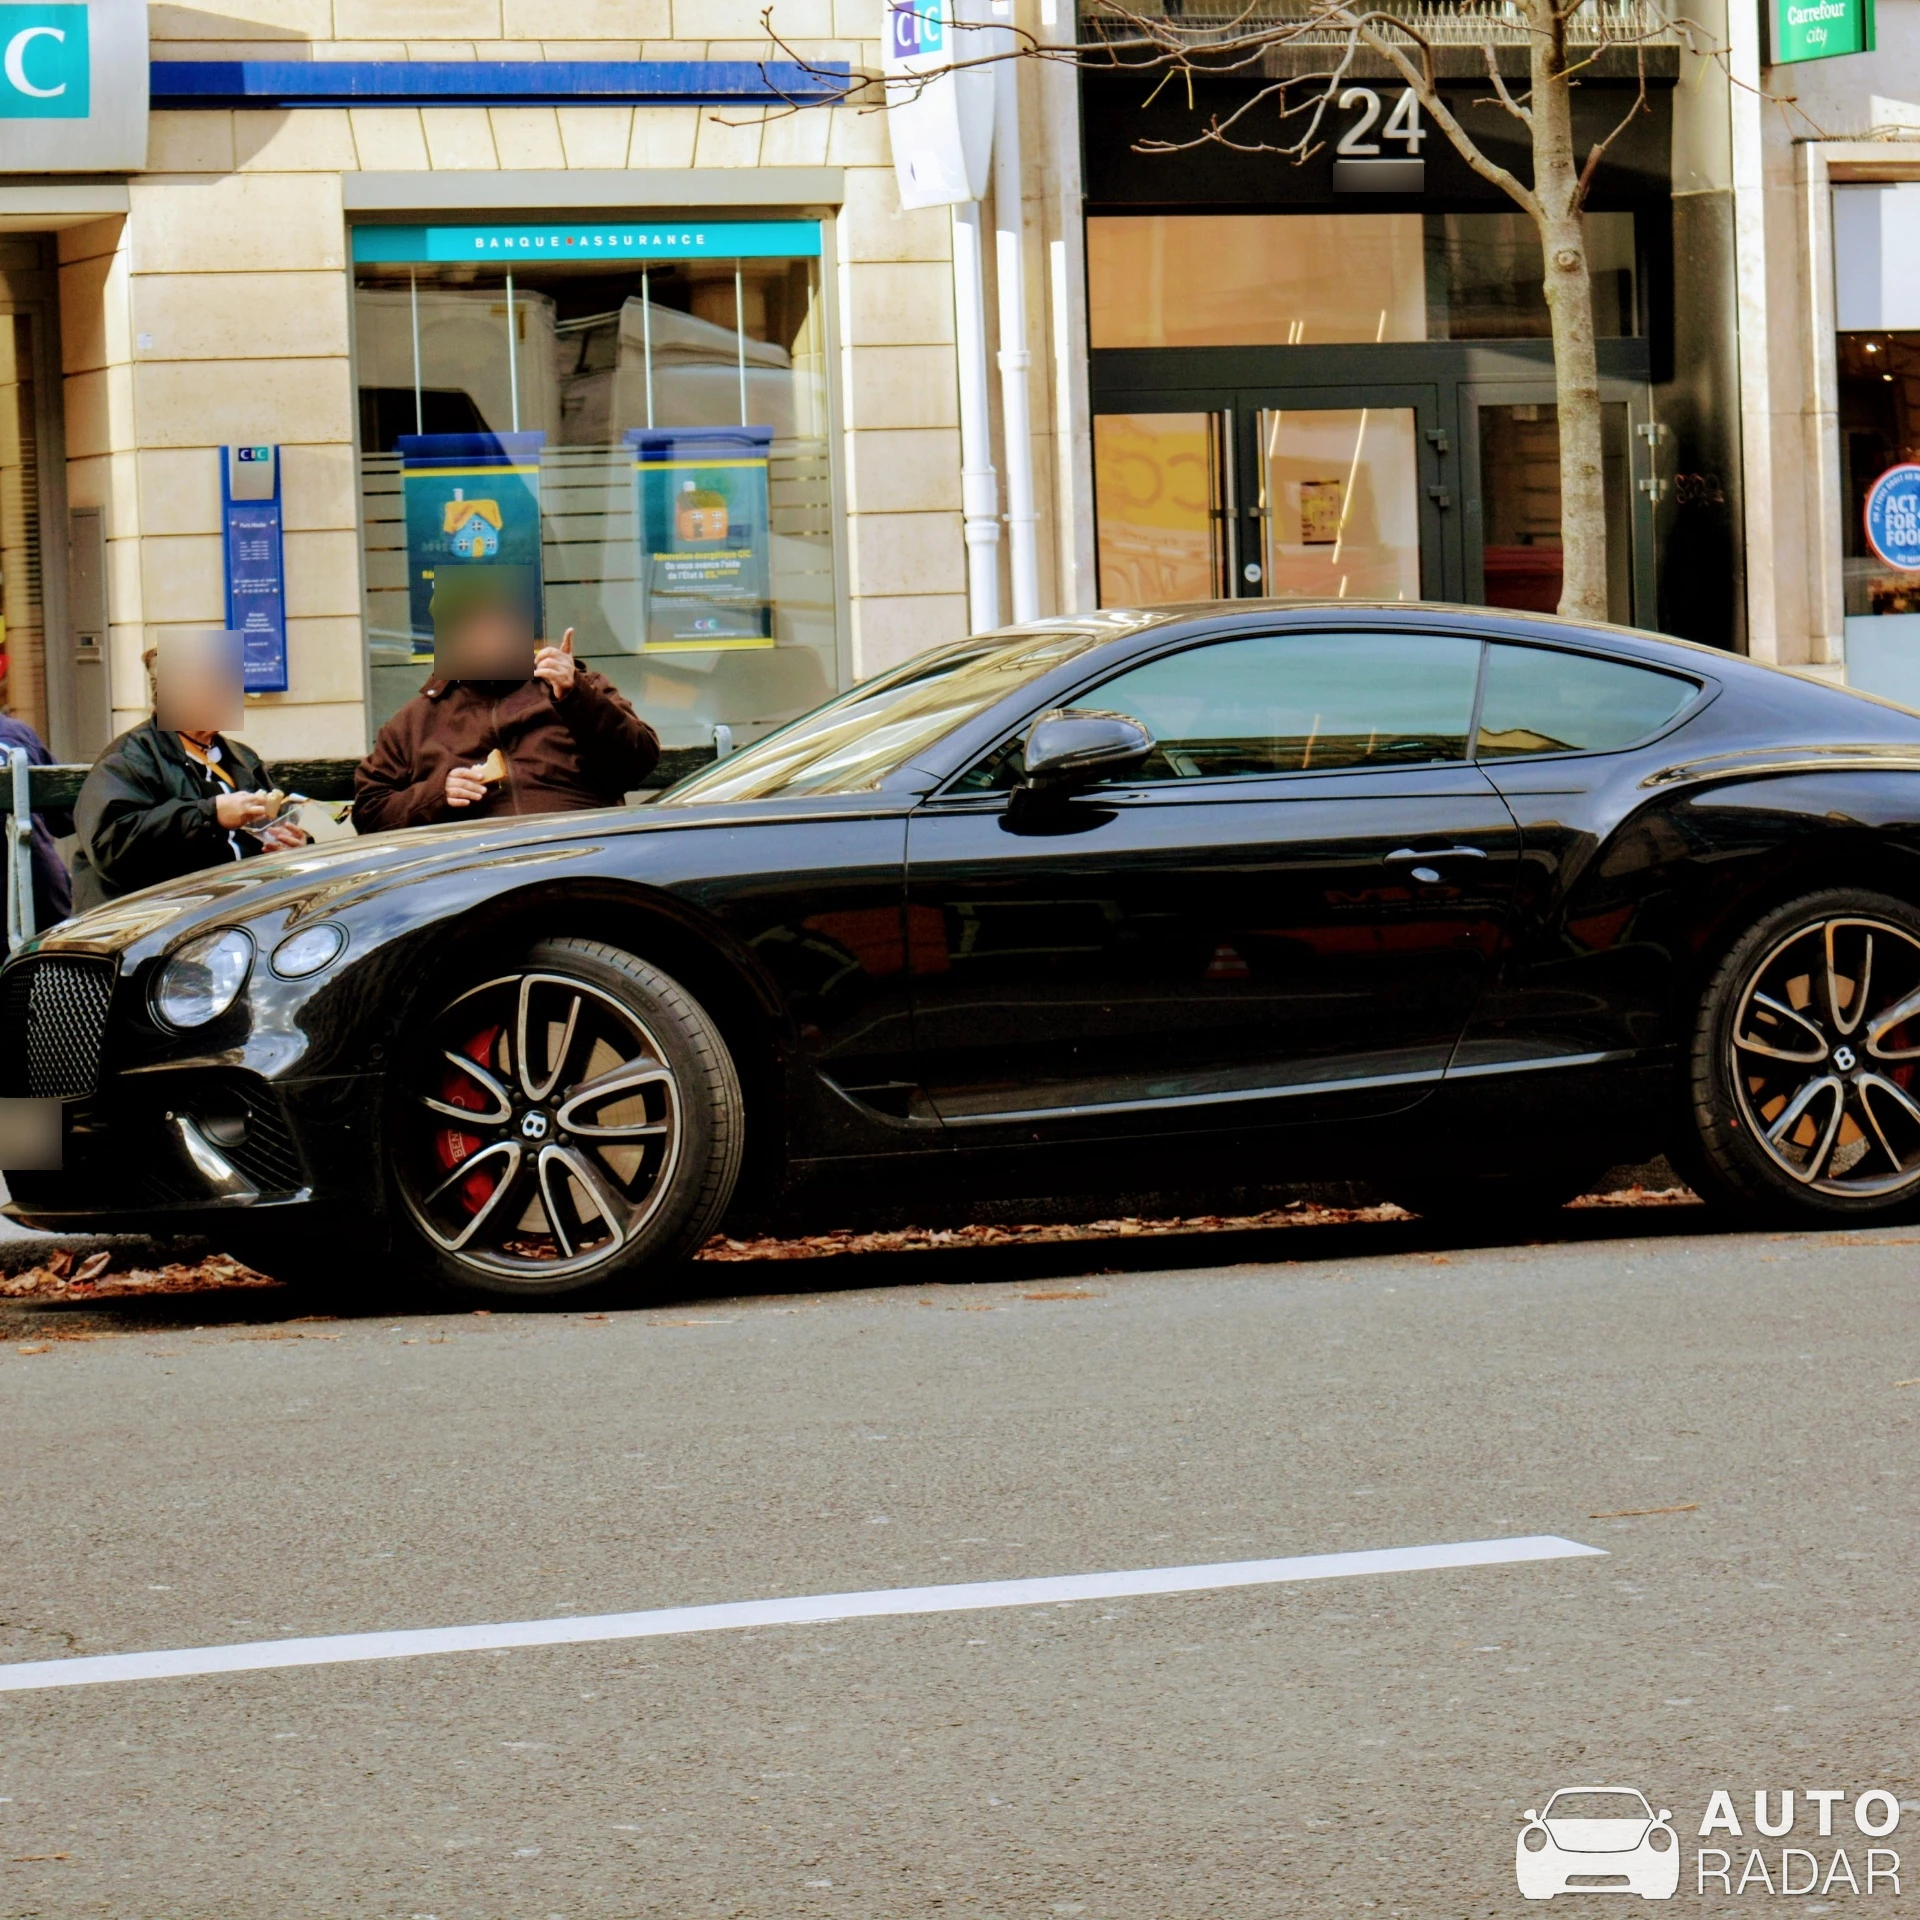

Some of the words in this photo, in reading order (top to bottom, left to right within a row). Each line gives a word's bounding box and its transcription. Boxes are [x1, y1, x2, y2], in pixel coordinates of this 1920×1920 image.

[1787, 0, 1846, 26] Carrefour
[896, 5, 939, 47] CIC
[1806, 26, 1828, 48] city
[1336, 86, 1427, 155] 24
[475, 236, 560, 248] BANQUE
[579, 234, 705, 247] ASSURANCE
[240, 449, 267, 460] CIC
[1885, 494, 1918, 514] ACT
[1885, 512, 1917, 531] FOR
[1885, 528, 1920, 548] FOO
